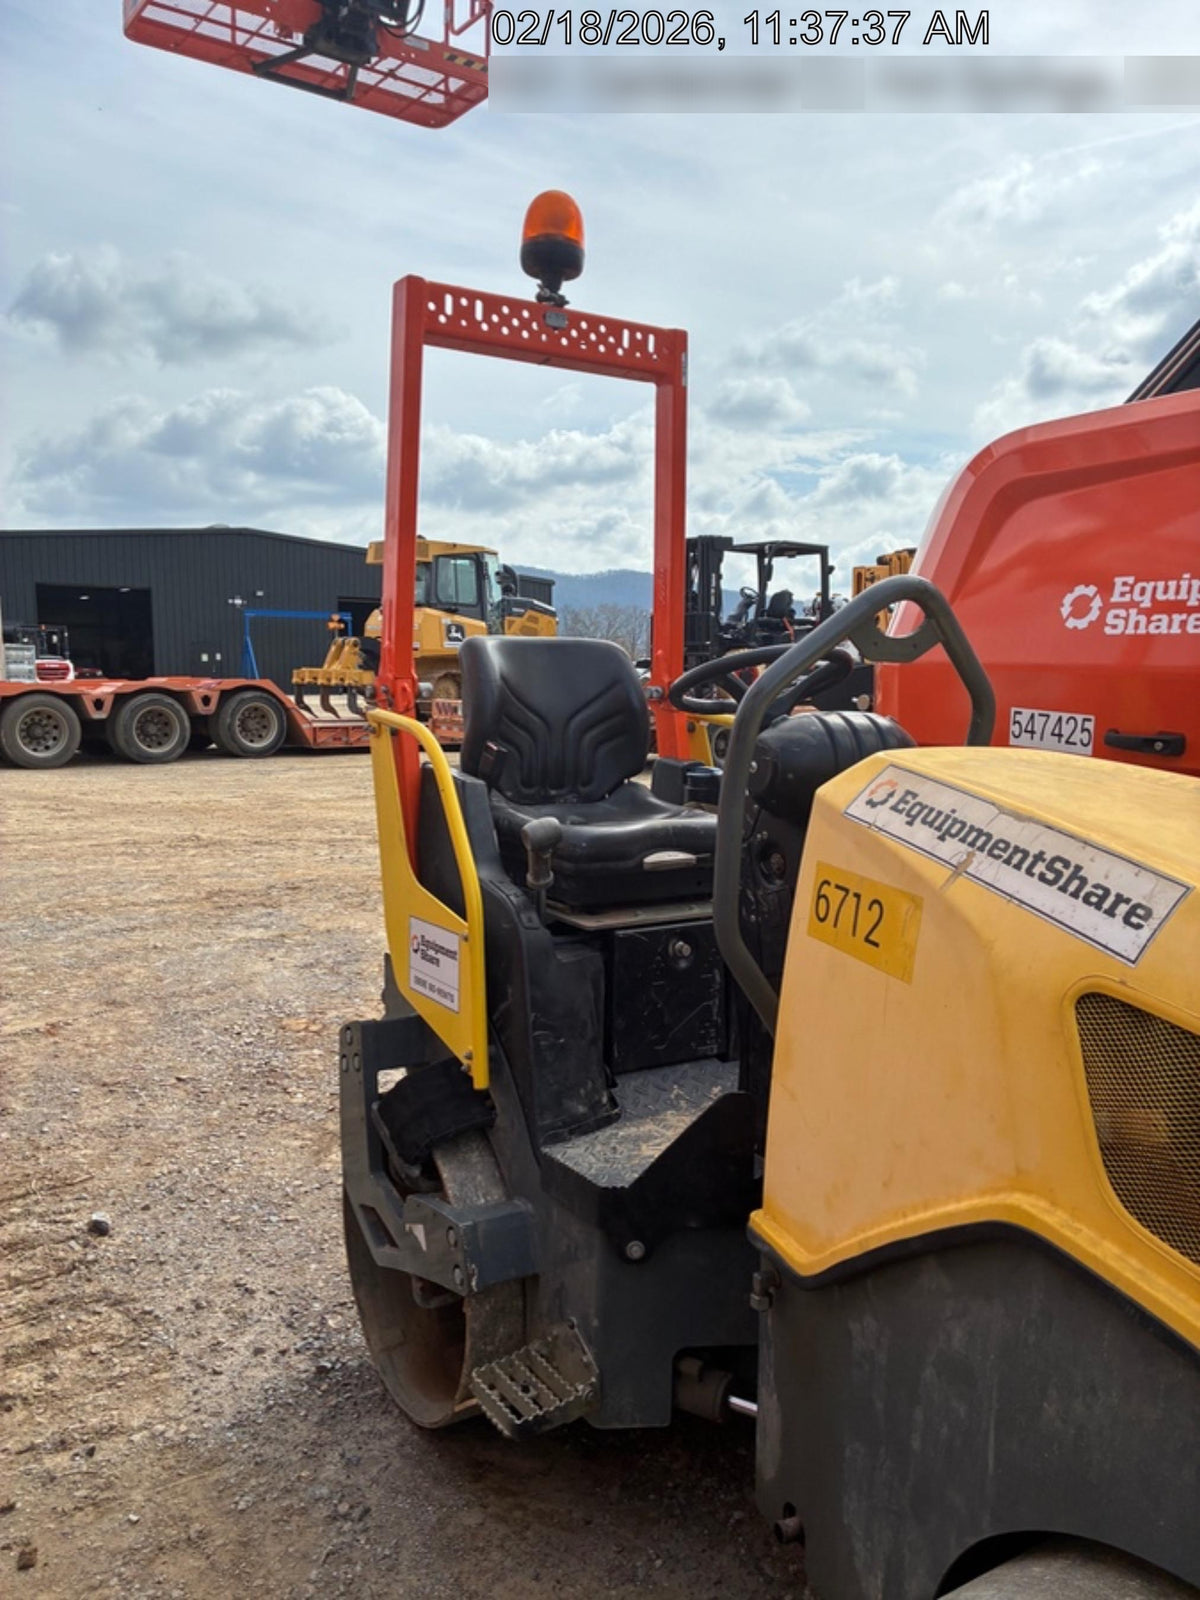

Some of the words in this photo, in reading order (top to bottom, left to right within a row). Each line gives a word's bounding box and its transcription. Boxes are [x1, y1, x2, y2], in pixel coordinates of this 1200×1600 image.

[1104, 608, 1200, 635] Share
[1011, 710, 1093, 748] 547425
[889, 788, 1154, 932] EquipmentShare
[814, 879, 885, 949] 6712
